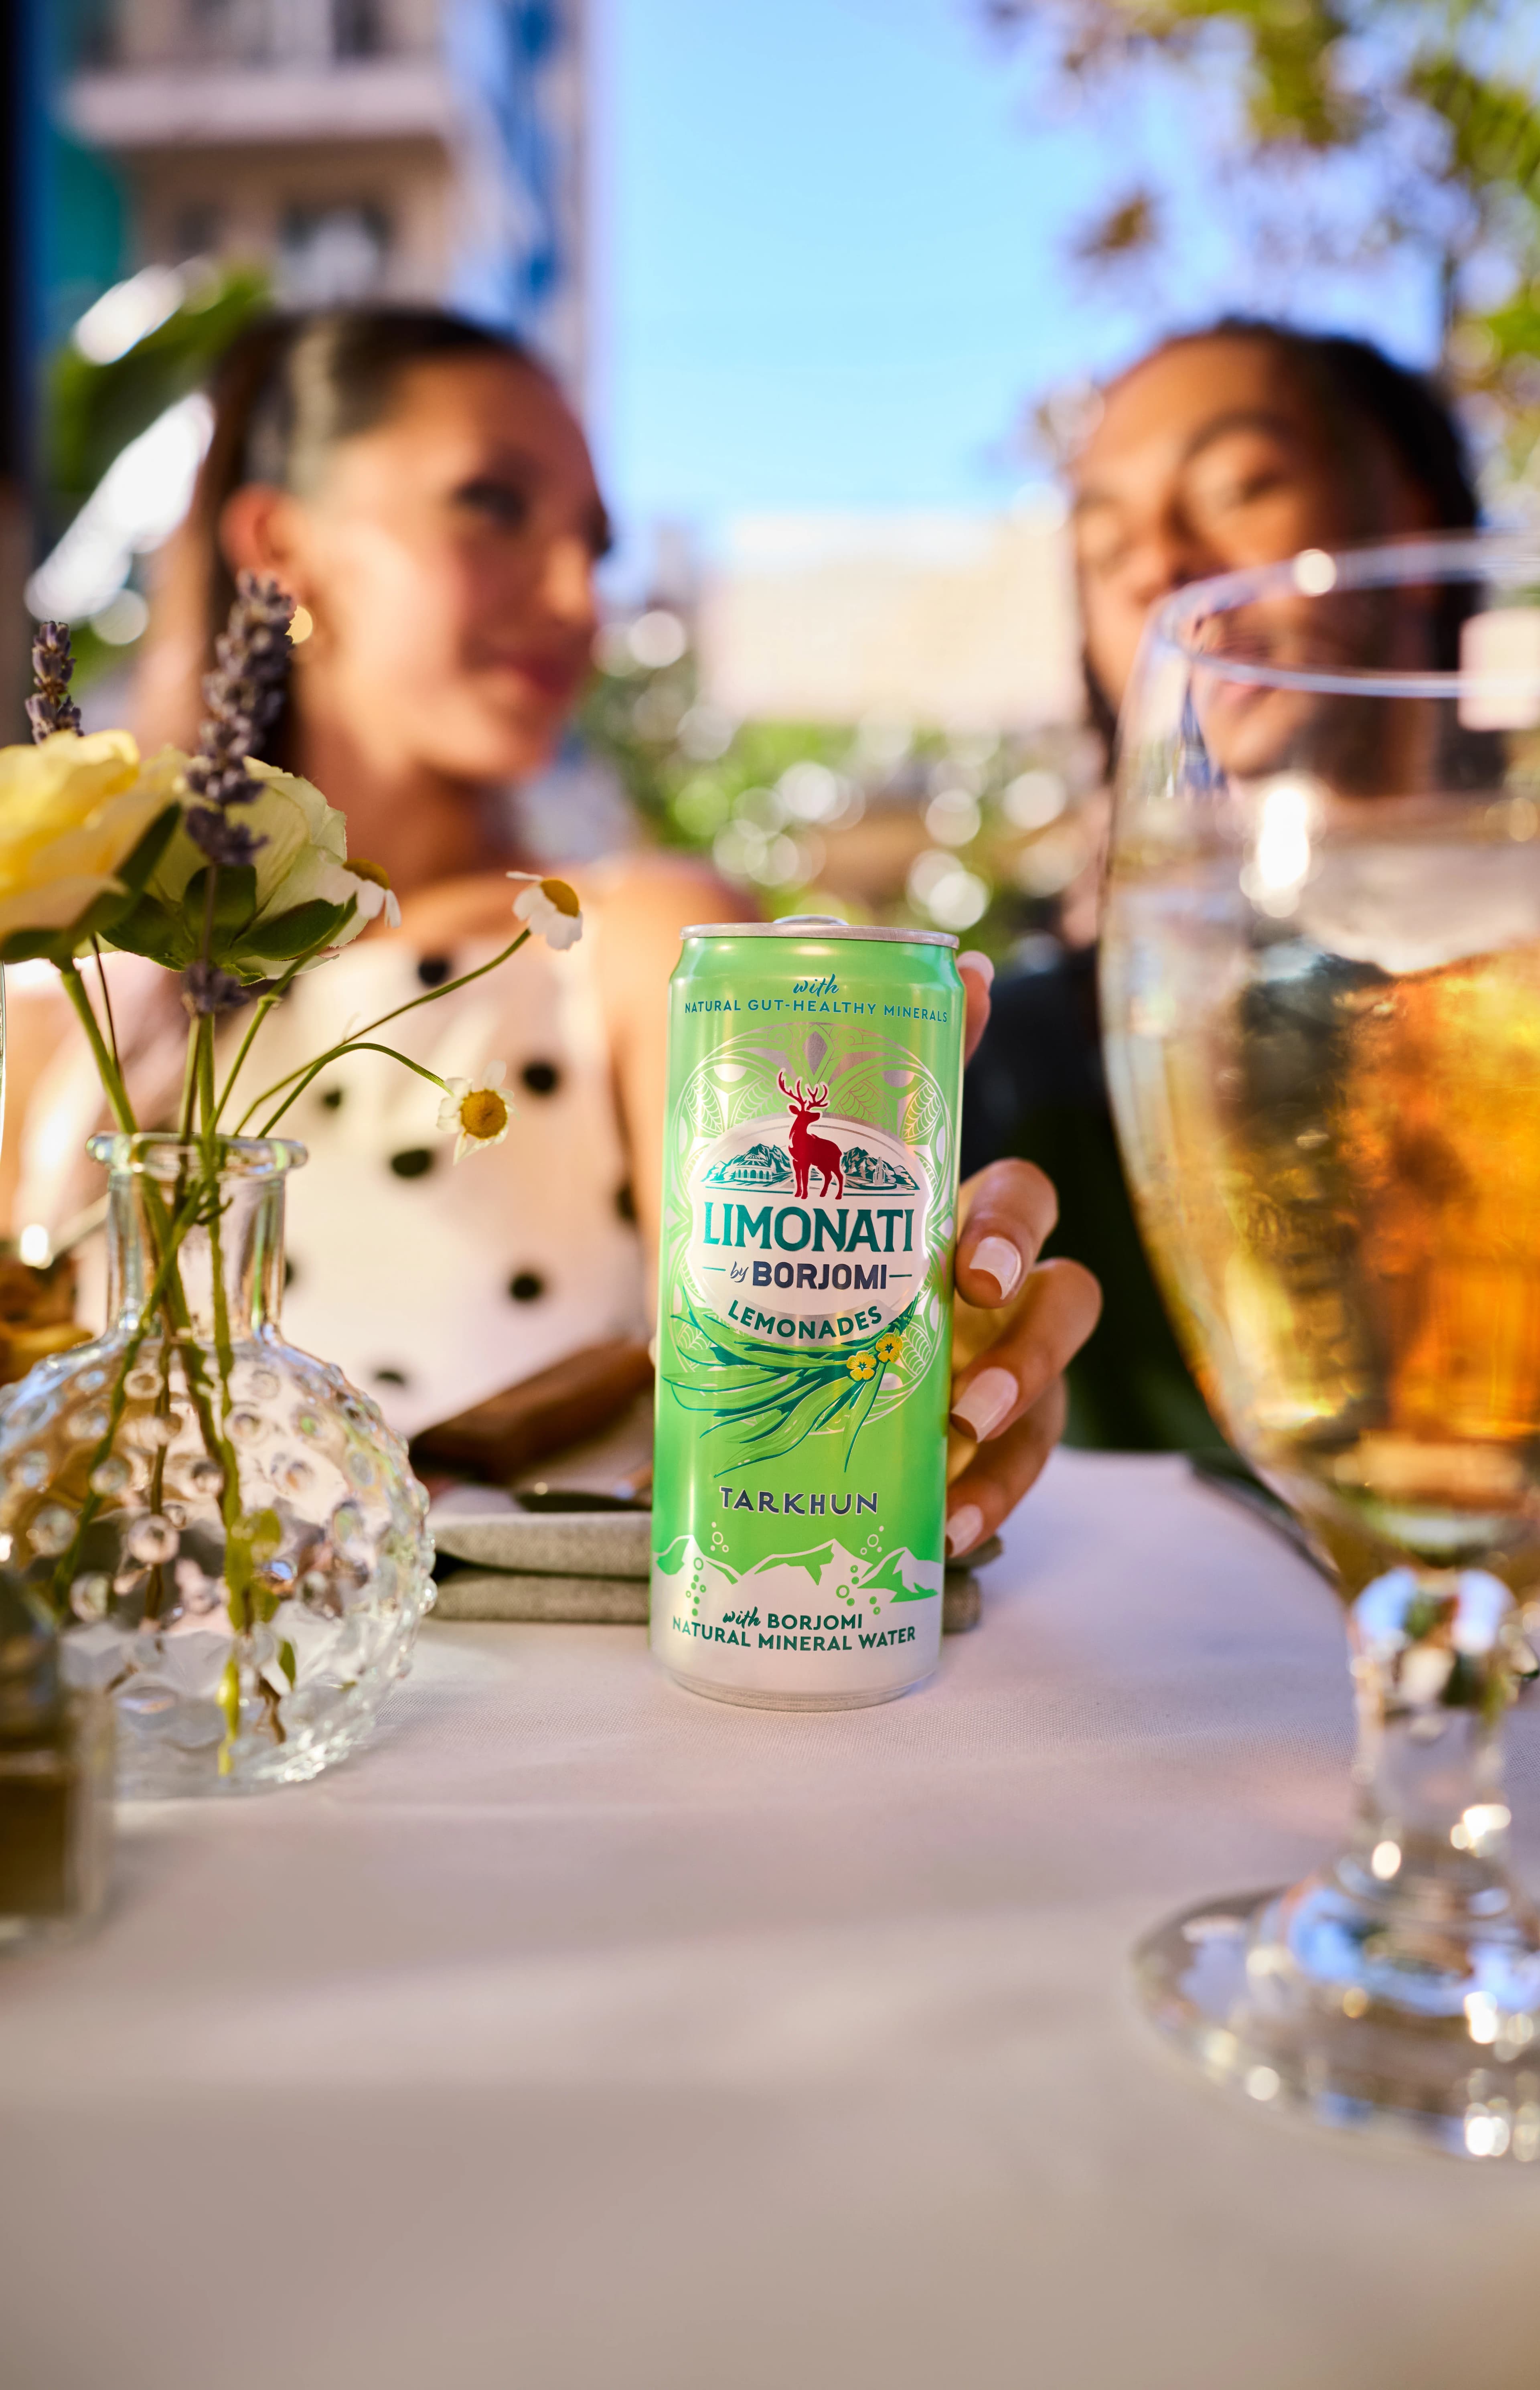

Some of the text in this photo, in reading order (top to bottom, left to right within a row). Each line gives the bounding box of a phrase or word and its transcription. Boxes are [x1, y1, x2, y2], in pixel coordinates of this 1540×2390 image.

[793, 974, 839, 997] with
[685, 999, 947, 1023] NATURAL GUT-HEALTHY MINERALS
[703, 1202, 915, 1252] LIMONATI
[730, 1261, 887, 1289] by BORJOMI
[728, 1300, 882, 1339] LEMONADES
[719, 1486, 878, 1516] TARKHUN
[723, 1606, 863, 1630] with BORJOMI
[673, 1616, 916, 1651] NATURAL MINERAL WATER
